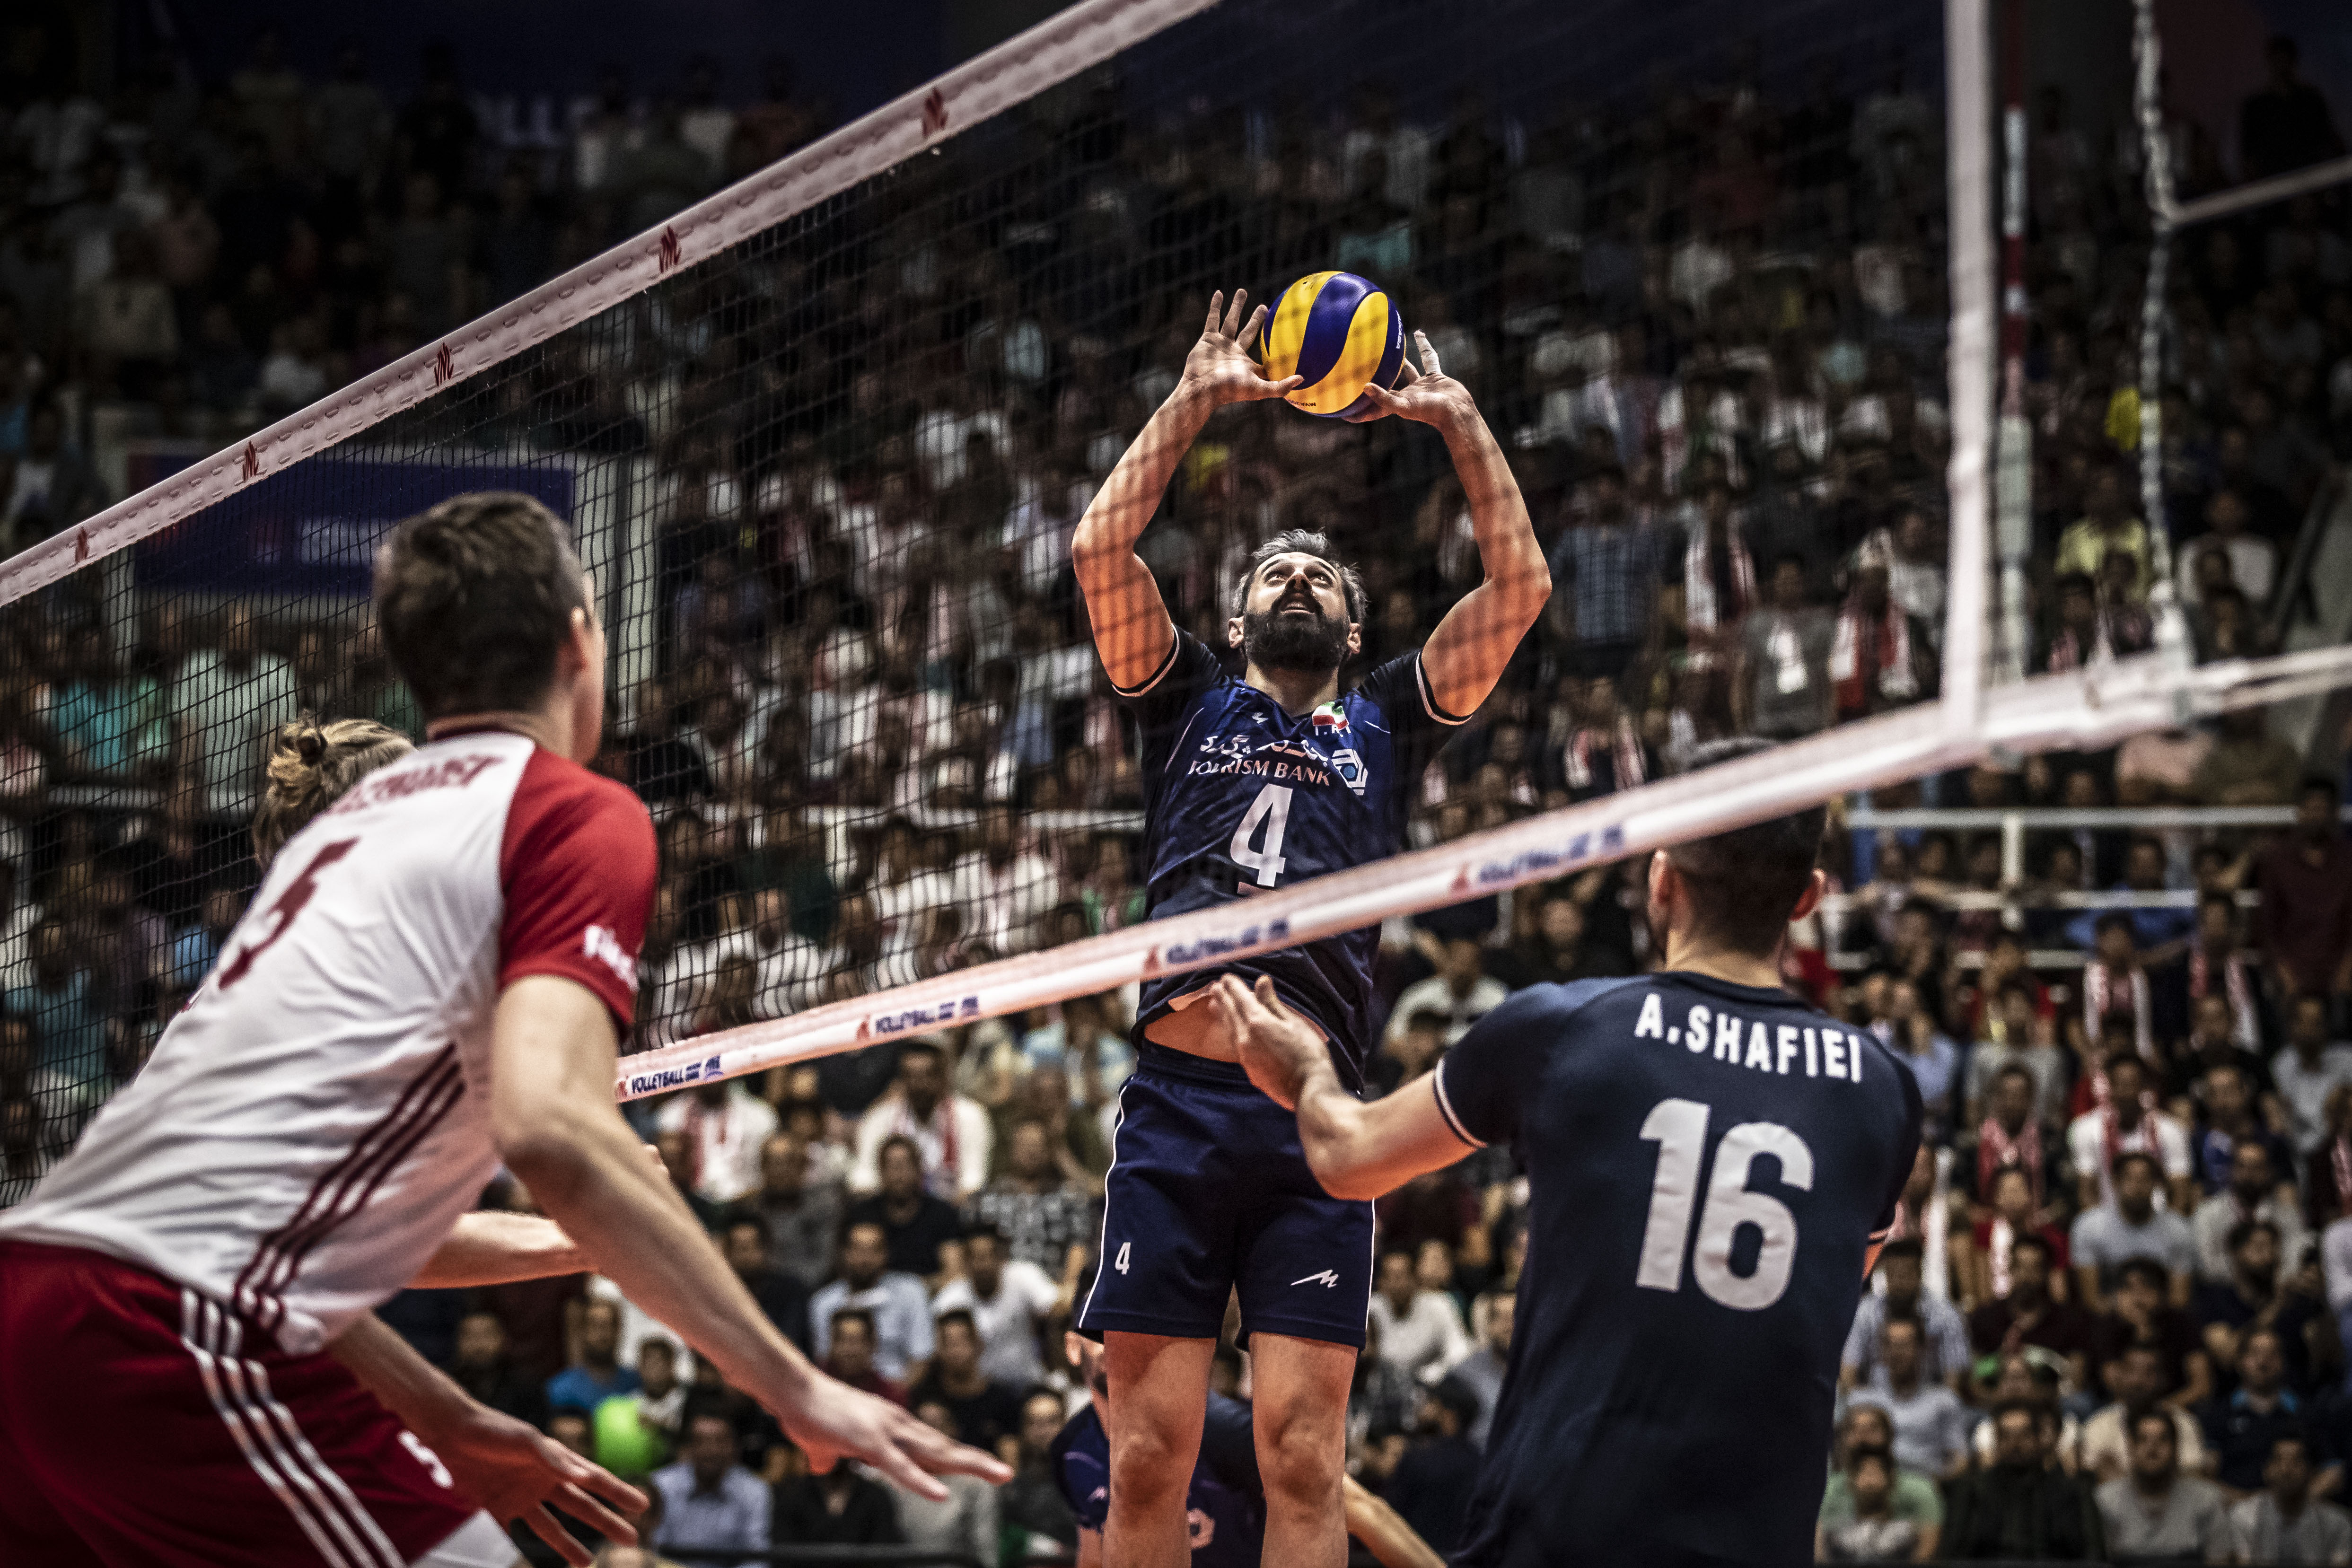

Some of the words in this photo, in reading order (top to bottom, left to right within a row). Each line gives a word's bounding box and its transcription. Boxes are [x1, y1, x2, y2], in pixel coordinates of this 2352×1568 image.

[1274, 762, 1331, 787] BANK
[1229, 783, 1293, 887] 4
[1635, 992, 1862, 1083] A.SHAFIEI
[632, 1068, 684, 1093] VOLLEYBALL
[1635, 1097, 1814, 1311] 16
[1115, 1242, 1131, 1275] 4
